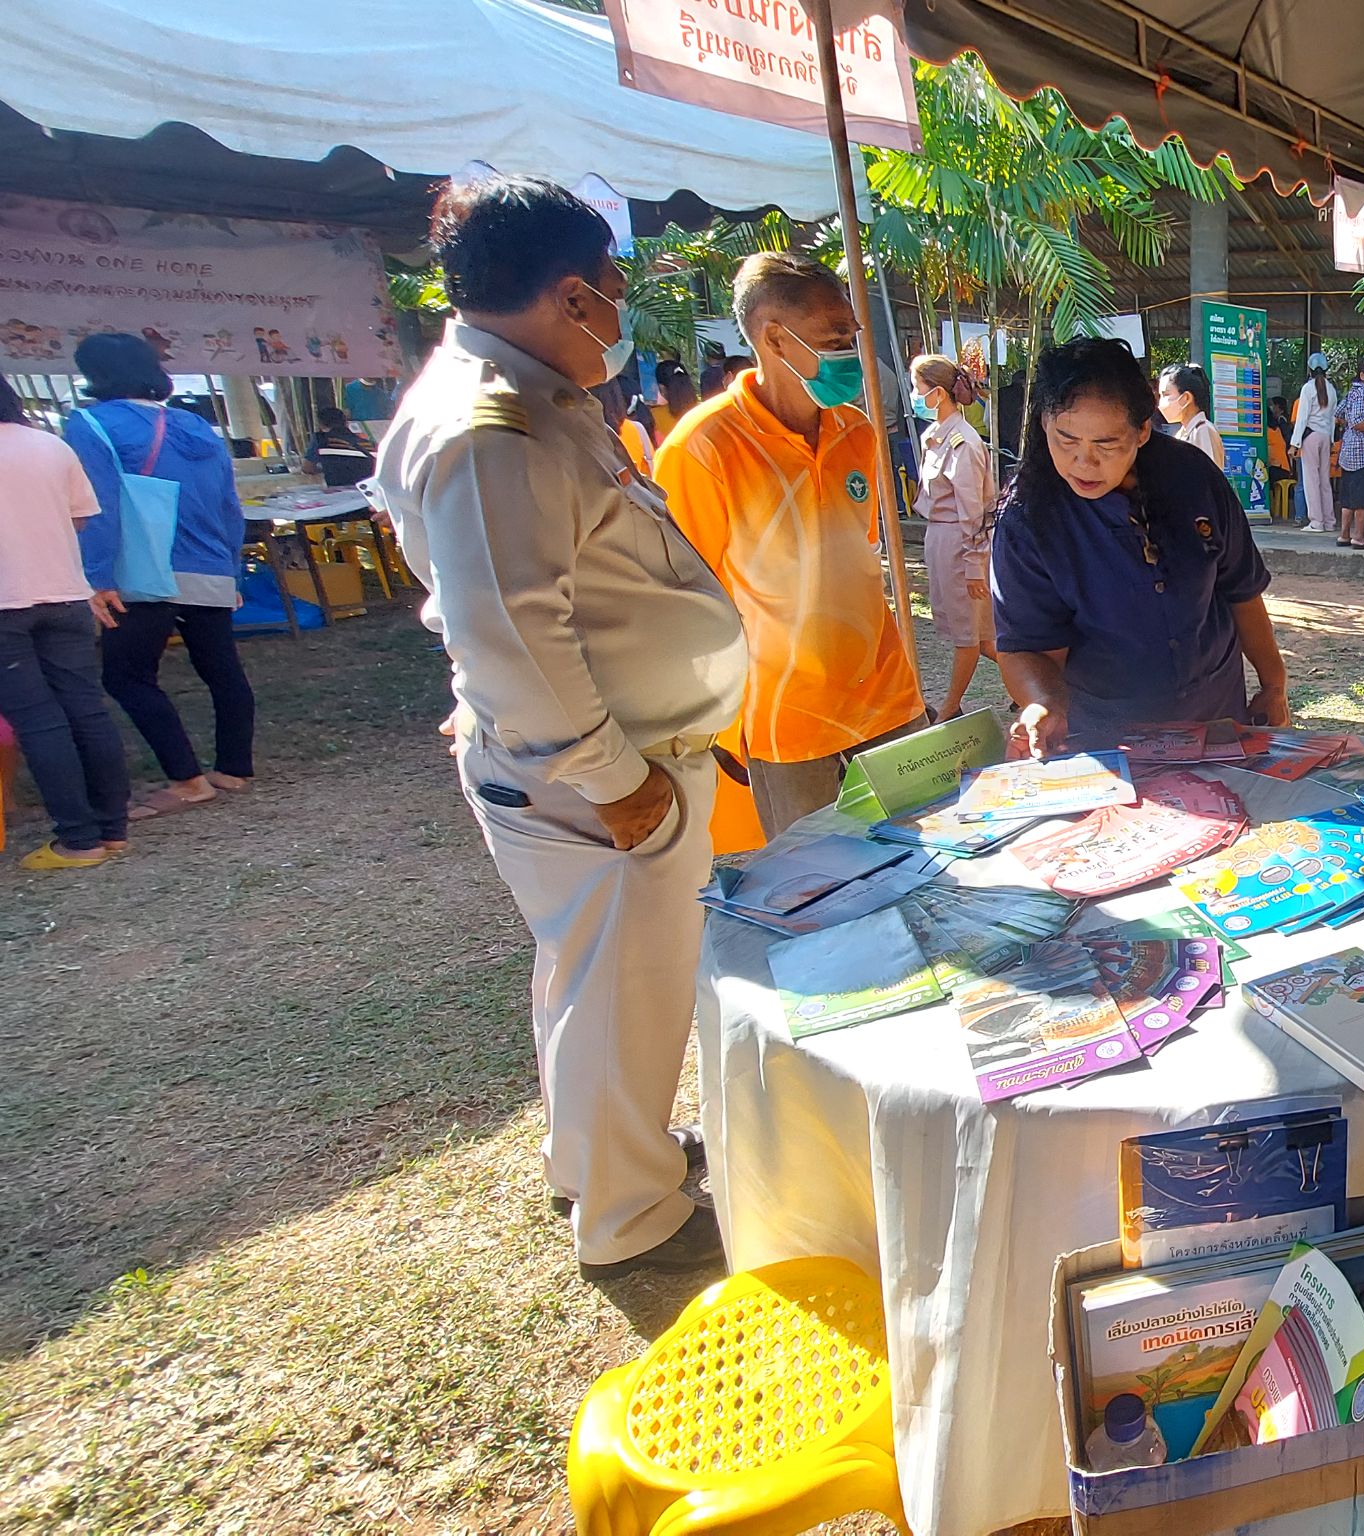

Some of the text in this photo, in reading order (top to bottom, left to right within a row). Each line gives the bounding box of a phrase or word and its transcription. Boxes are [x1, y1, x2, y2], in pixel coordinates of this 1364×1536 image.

[96, 253, 145, 273] ONE
[156, 259, 214, 276] HOME
[1227, 326, 1236, 336] 40
[1300, 1263, 1336, 1311] โครงการ
[1143, 1311, 1258, 1351] เทคนิคการเลี้
